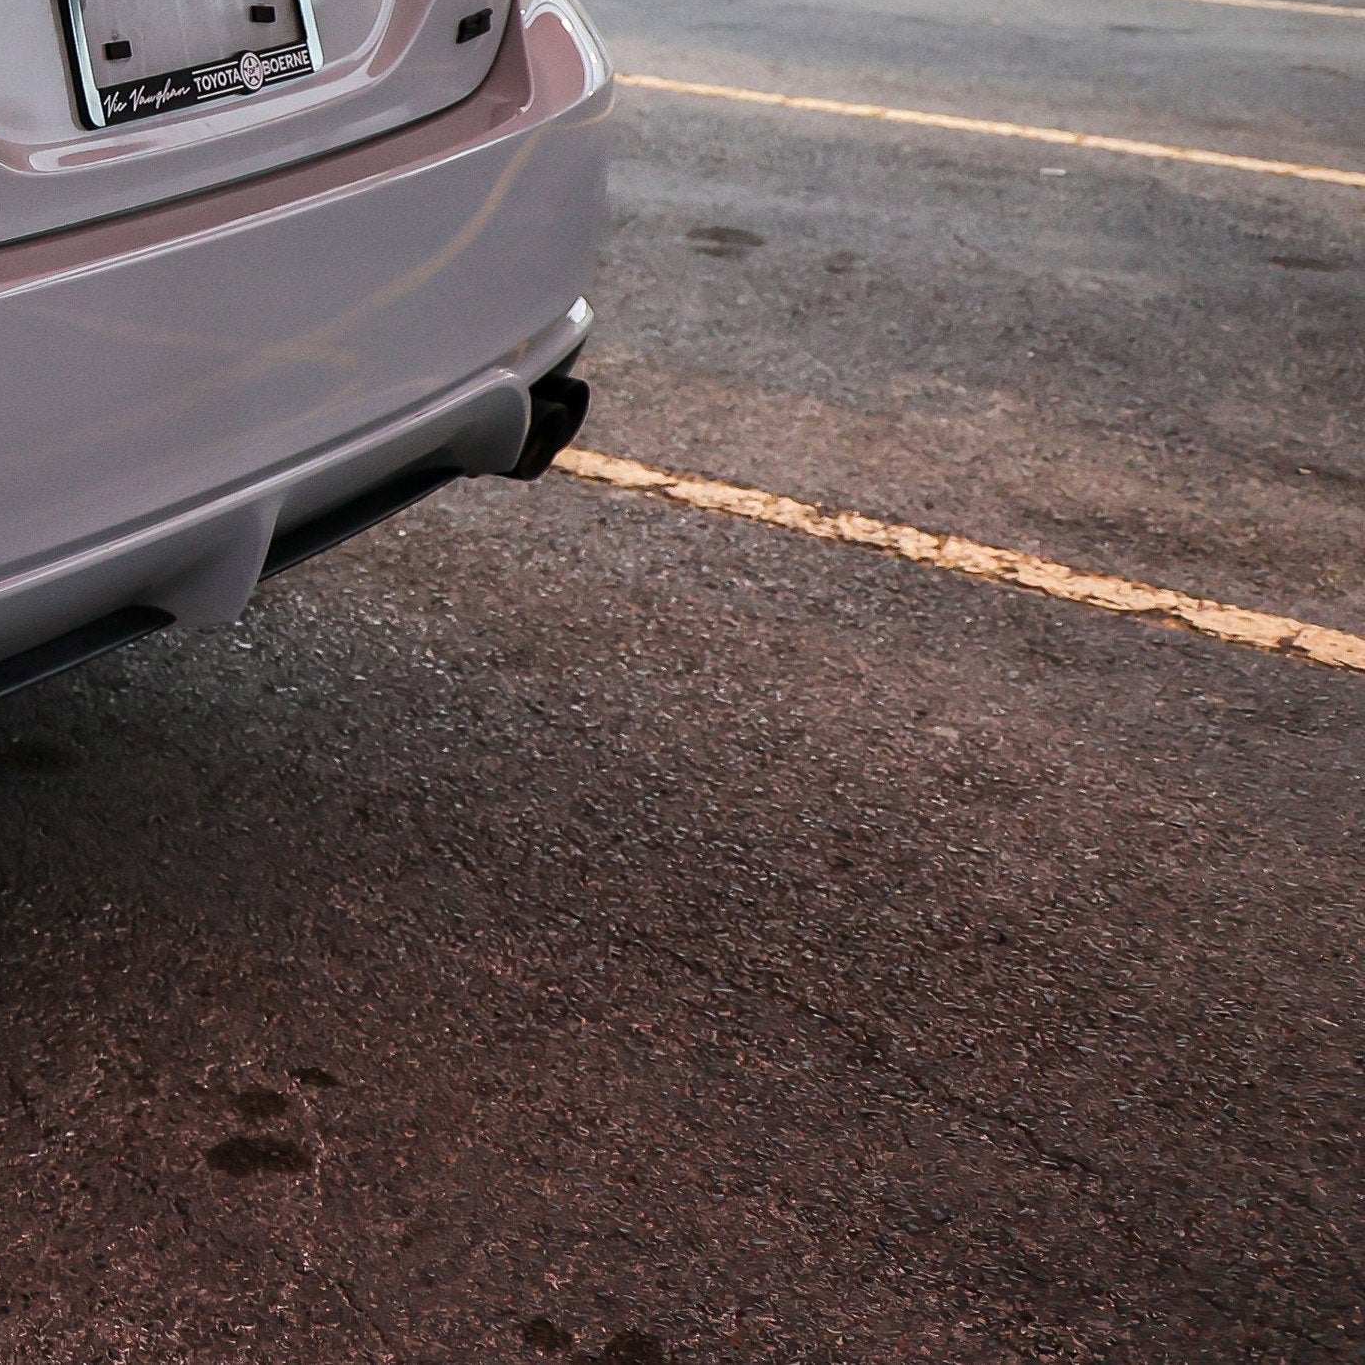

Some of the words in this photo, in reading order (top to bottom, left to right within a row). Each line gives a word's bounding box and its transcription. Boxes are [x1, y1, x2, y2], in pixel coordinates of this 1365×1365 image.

[193, 68, 242, 93] TOYOTA
[262, 50, 311, 76] BOERNE
[103, 91, 128, 118] Vic
[129, 78, 191, 112] Vaughan
